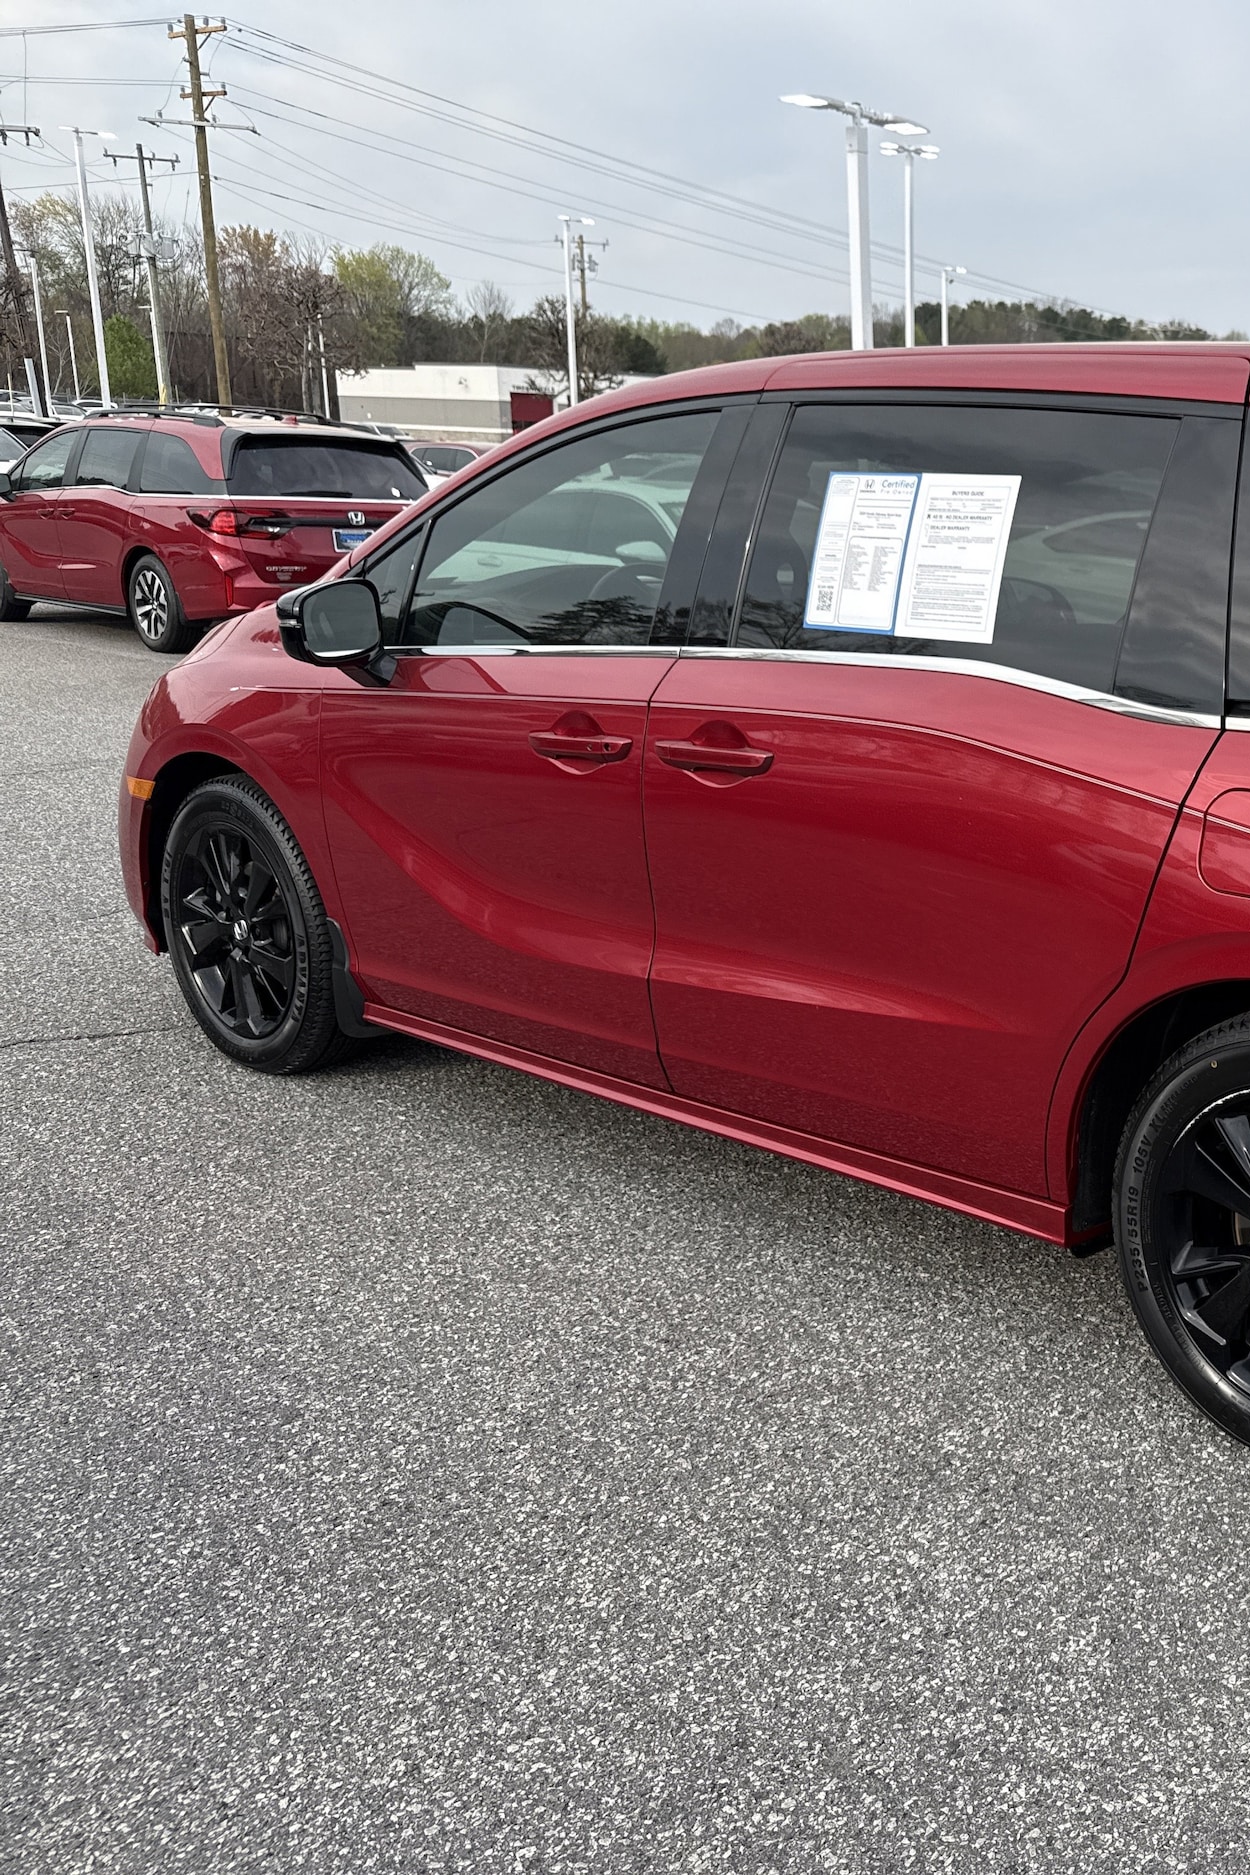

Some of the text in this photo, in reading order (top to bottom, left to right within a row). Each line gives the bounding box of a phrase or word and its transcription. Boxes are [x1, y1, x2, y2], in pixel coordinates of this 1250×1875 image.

[881, 479, 915, 489] Certified
[290, 933, 310, 1023] ADVANTA
[1132, 1135, 1154, 1174] 105V
[1125, 1185, 1149, 1293] P235/55R19
